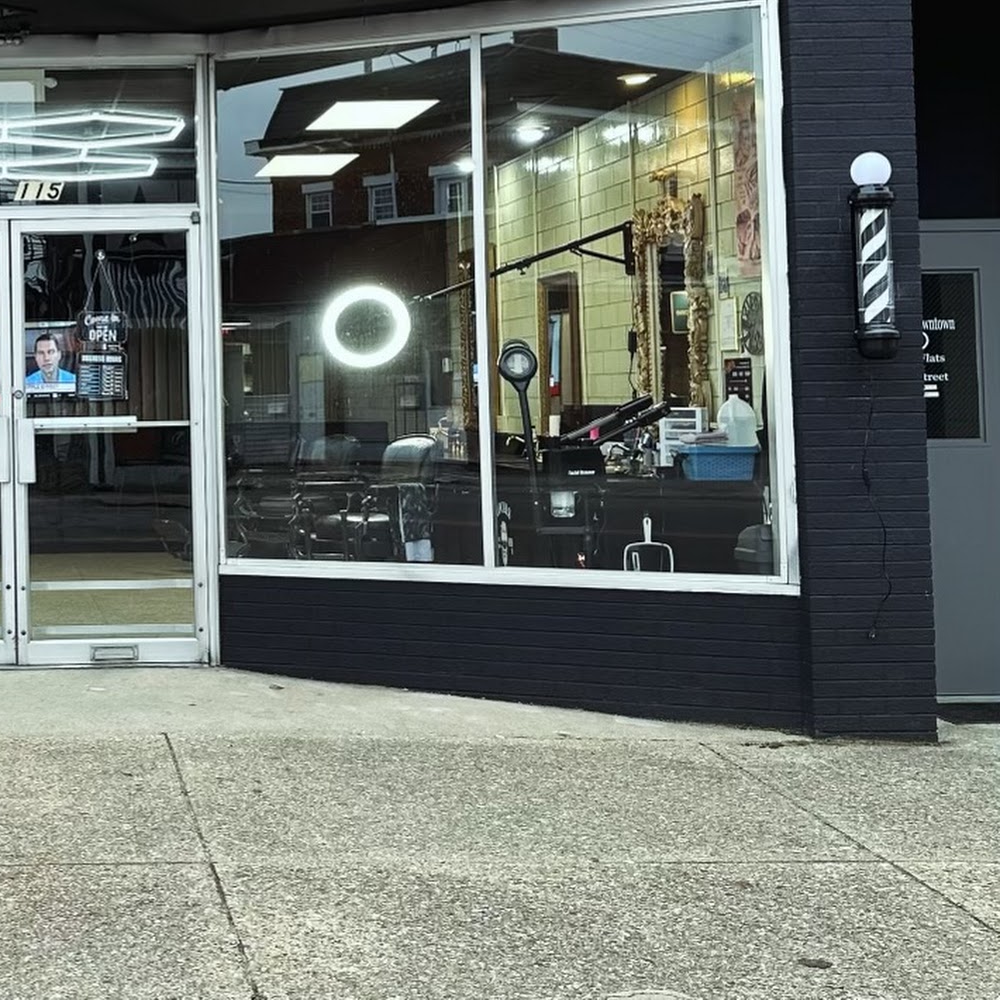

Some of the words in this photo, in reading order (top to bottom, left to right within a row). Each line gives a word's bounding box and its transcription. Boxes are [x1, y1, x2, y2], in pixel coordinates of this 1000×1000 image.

[20, 182, 61, 199] 115
[922, 317, 955, 330] wntown
[89, 329, 117, 342] OPEN
[923, 372, 949, 381] treet
